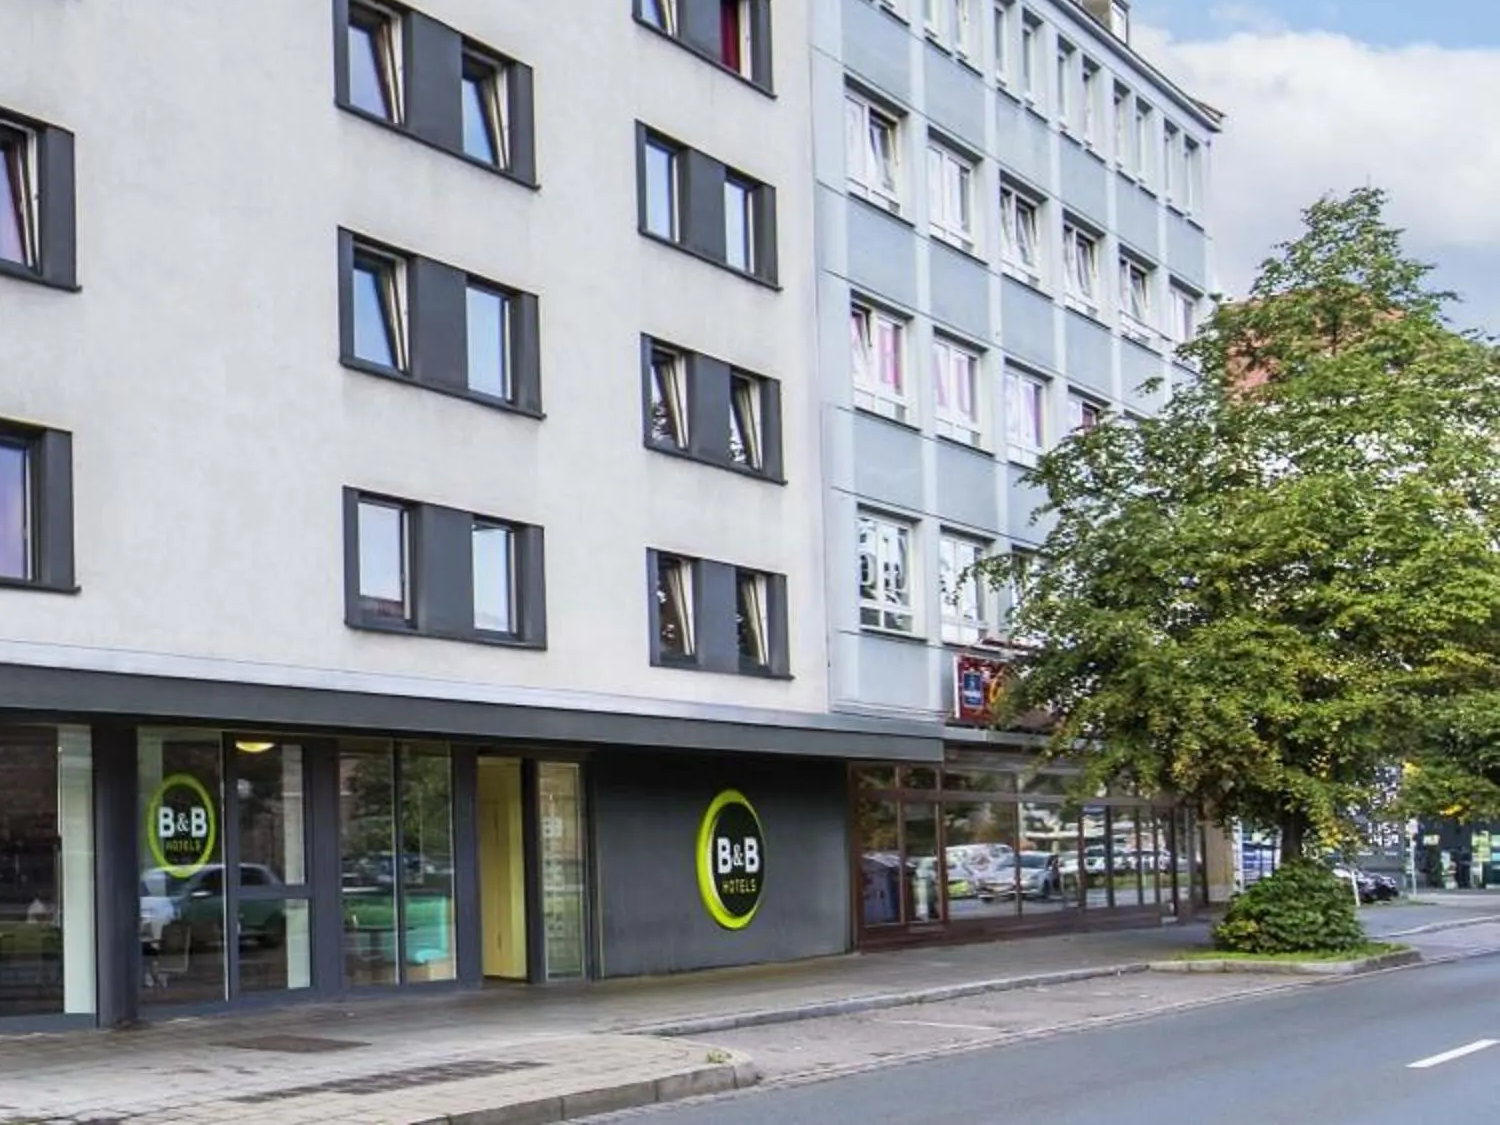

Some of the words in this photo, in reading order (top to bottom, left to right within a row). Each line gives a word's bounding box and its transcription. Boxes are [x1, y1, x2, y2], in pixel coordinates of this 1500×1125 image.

[159, 806, 207, 837] B&B
[717, 837, 760, 874] B&B
[723, 878, 757, 894] HOTELS
